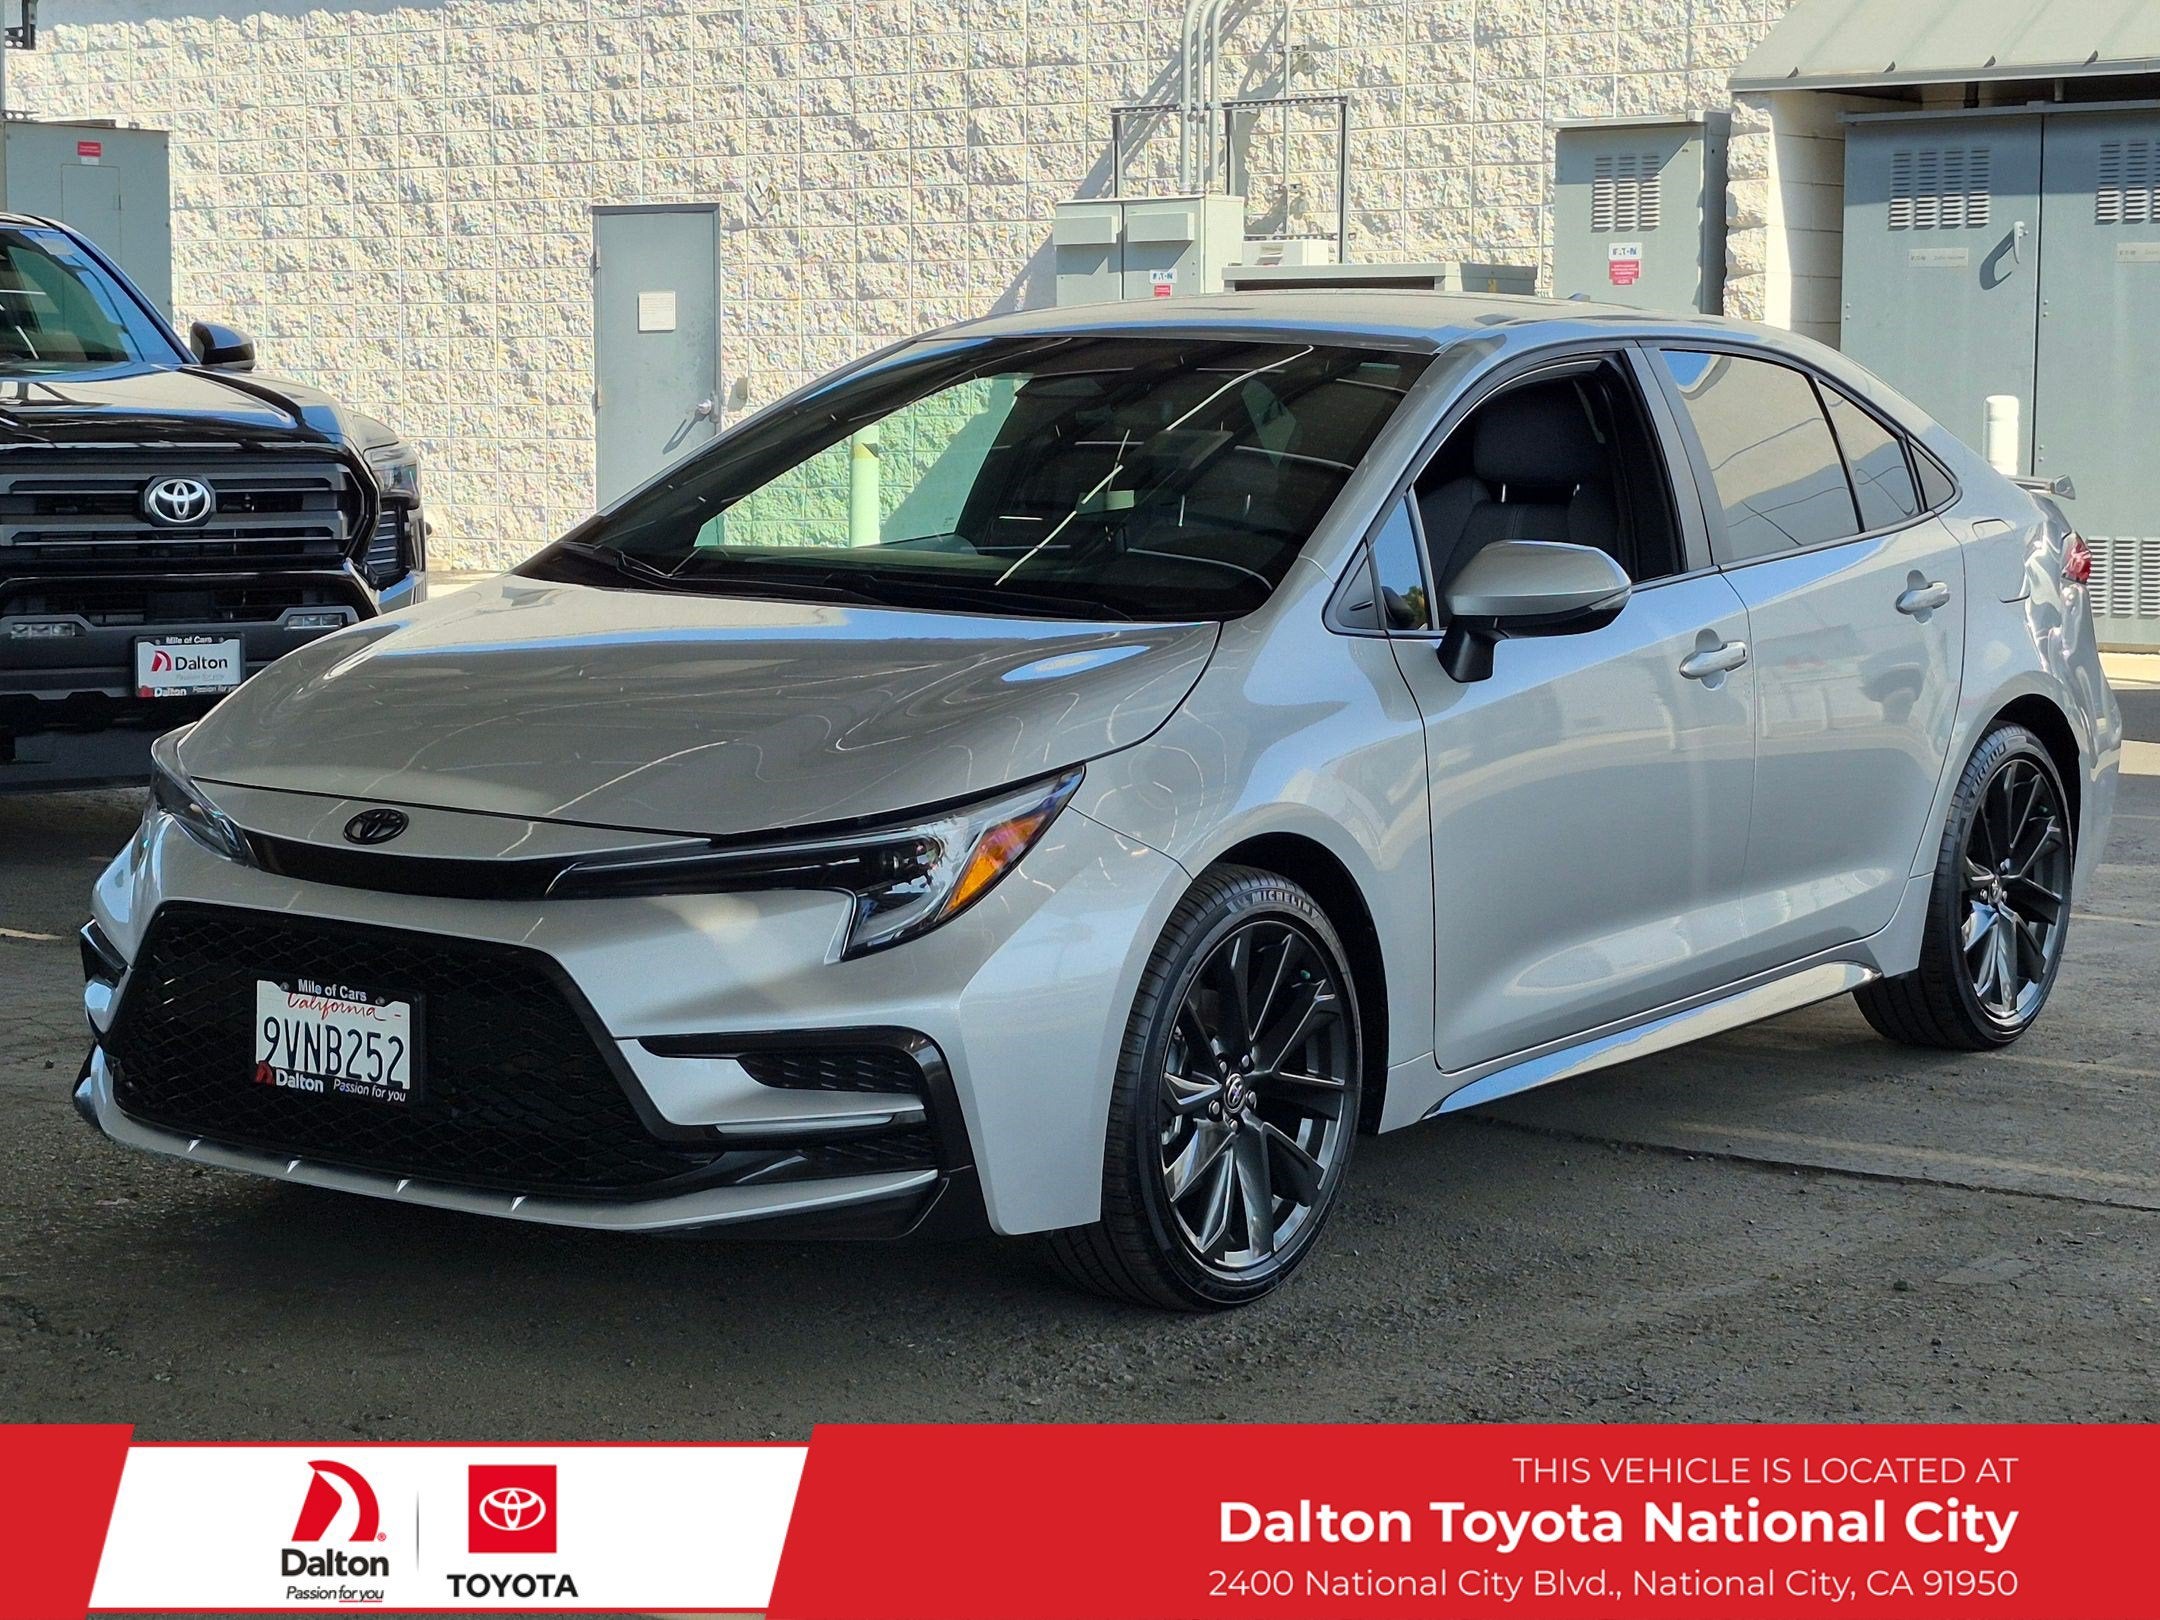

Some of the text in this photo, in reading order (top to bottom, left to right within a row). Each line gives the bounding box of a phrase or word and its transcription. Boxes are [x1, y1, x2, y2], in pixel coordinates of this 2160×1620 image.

[175, 656, 228, 671] Dalton
[154, 687, 187, 698] Dalton
[1252, 890, 1311, 914] MICHELIN
[298, 979, 367, 1001] Mile of Cars
[287, 992, 387, 1021] California
[264, 1016, 405, 1088] 9VNB252
[276, 1069, 406, 1103] Dalton Passion for you
